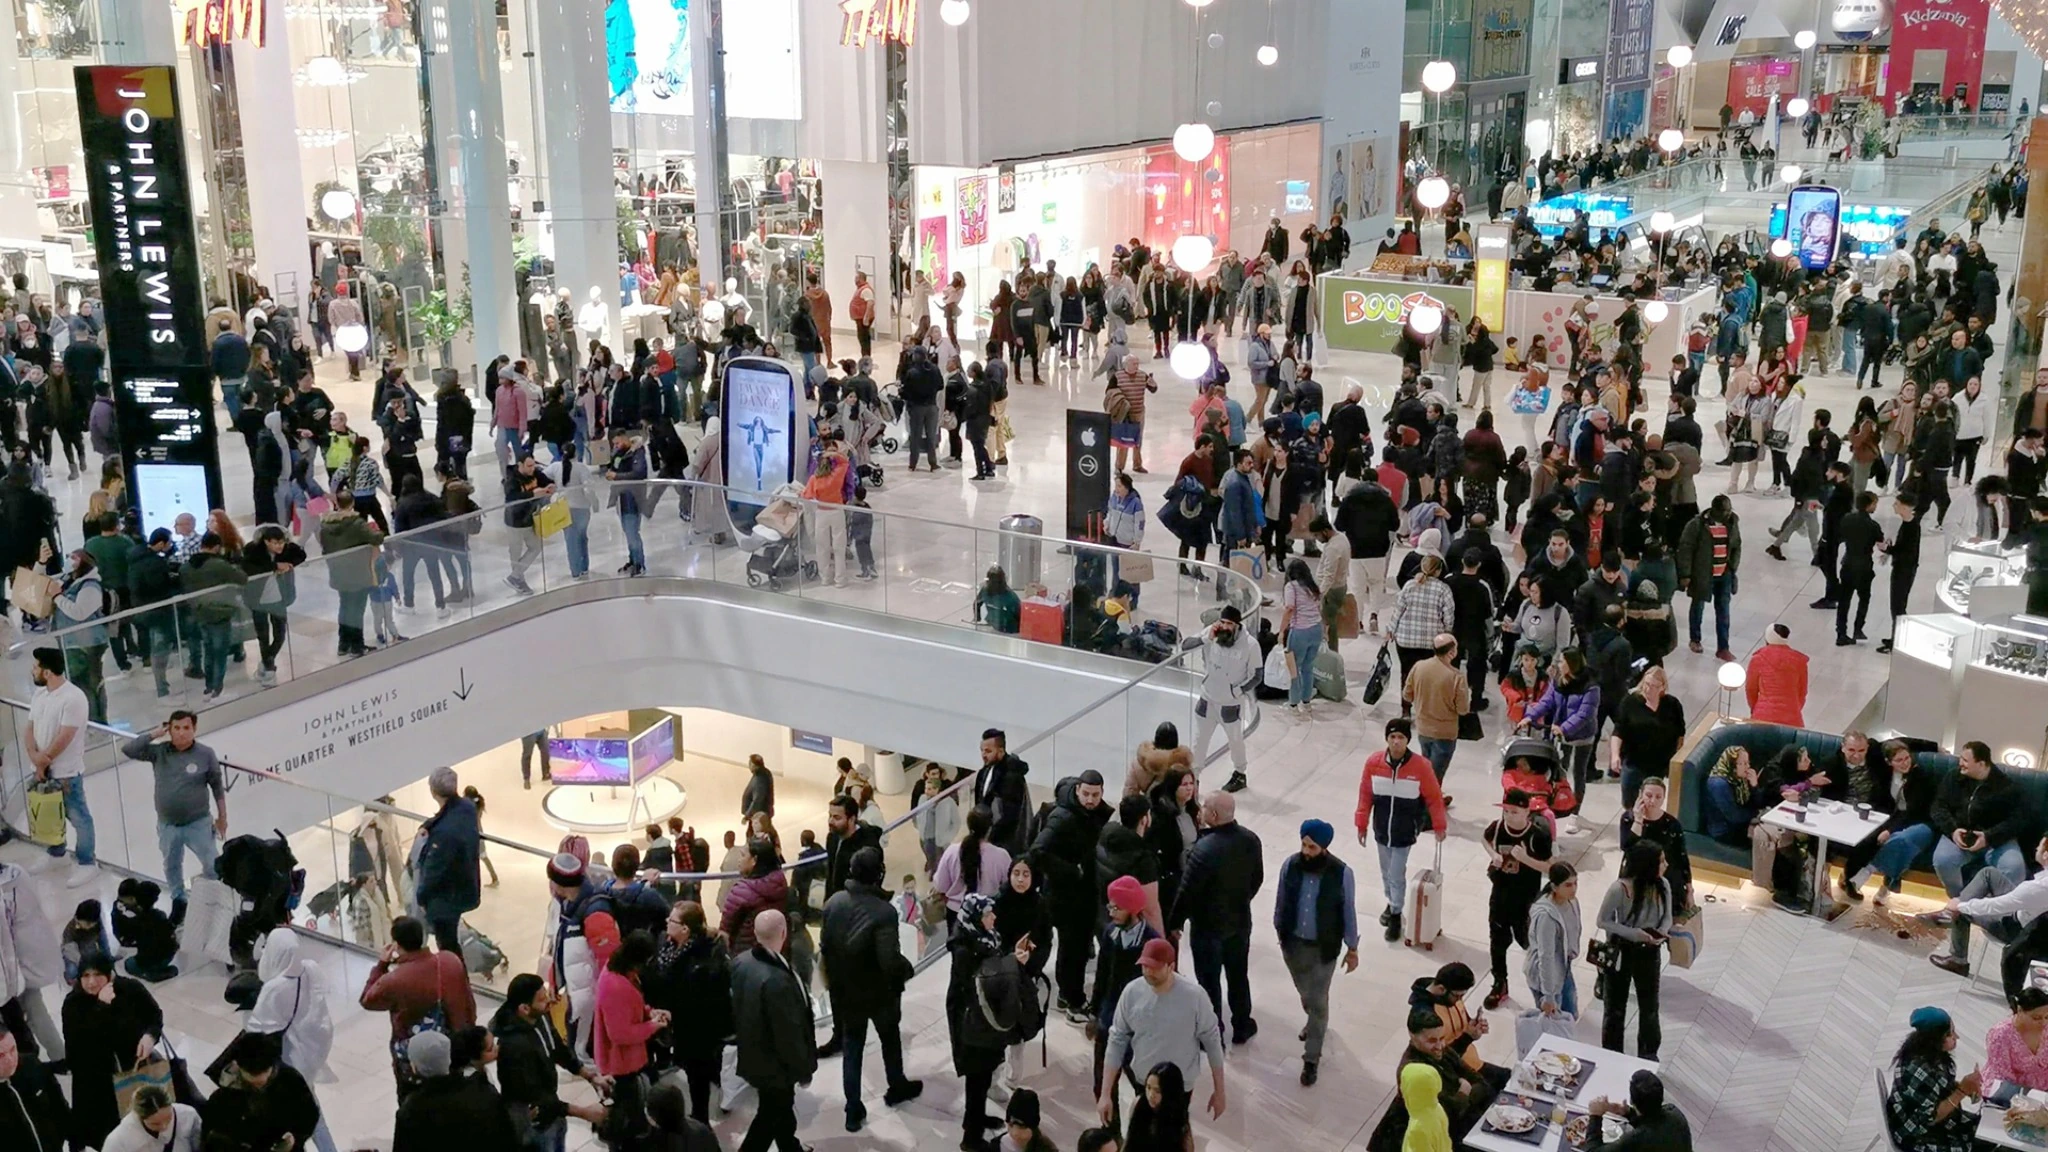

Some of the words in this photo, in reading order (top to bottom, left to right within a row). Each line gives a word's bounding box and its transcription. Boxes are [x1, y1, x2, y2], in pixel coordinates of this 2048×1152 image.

[1745, 84, 1762, 98] SALE
[116, 87, 160, 200] JOHN
[108, 164, 122, 176] &
[109, 181, 134, 273] PARTNERS
[137, 219, 176, 345] LEWIS
[739, 393, 780, 410] DANCE
[303, 708, 346, 735] JOHN
[351, 688, 398, 716] LEWIS
[331, 709, 384, 736] PARTNERS
[284, 742, 335, 773] QUARTER
[347, 715, 405, 748] WESTFIELD
[409, 698, 449, 724] SQUARE
